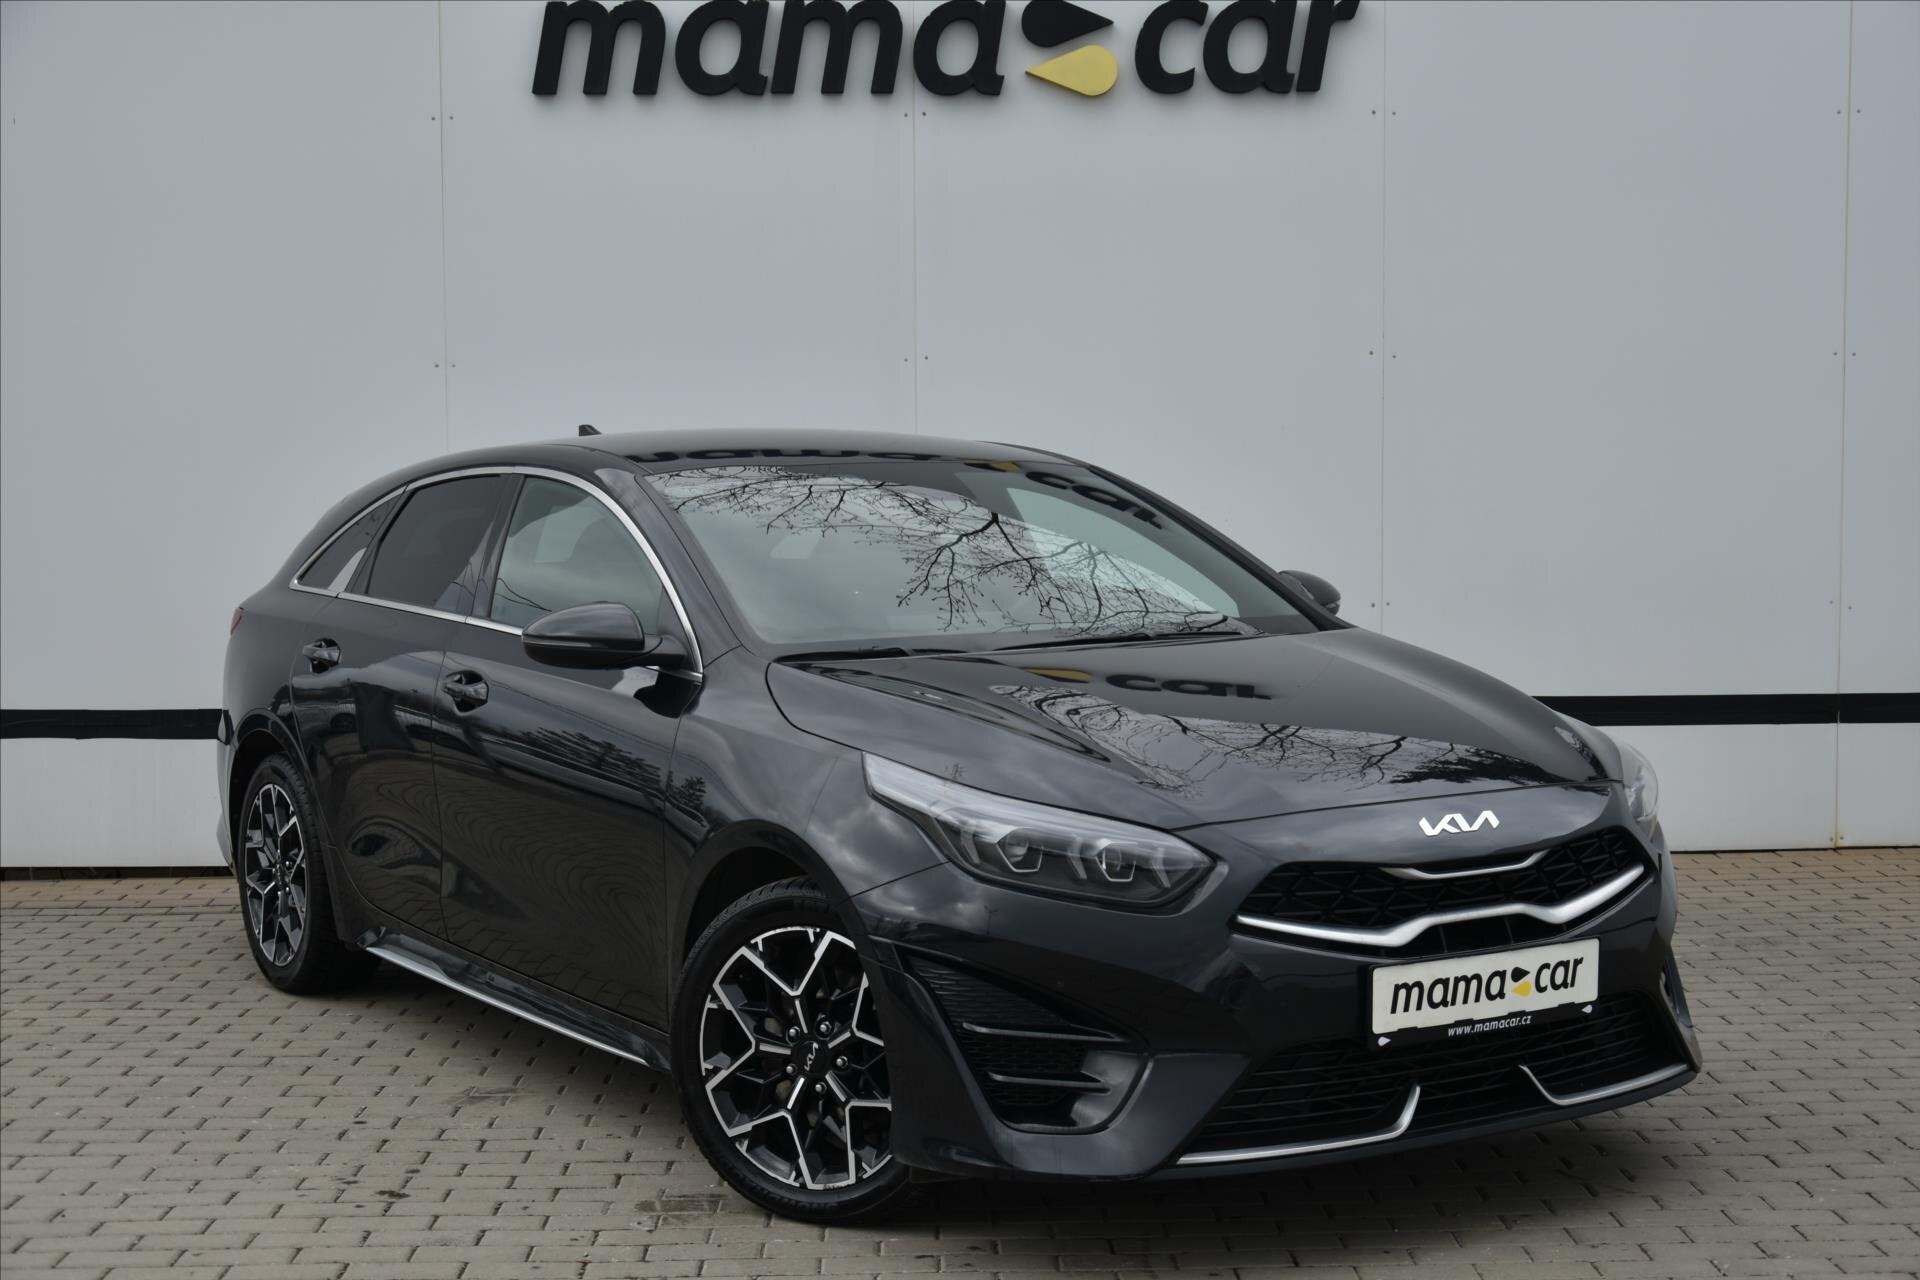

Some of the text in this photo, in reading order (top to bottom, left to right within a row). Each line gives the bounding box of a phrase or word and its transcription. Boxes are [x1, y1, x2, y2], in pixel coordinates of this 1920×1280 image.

[531, 0, 1360, 96] mama car
[1390, 957, 1584, 1014] mama car
[1448, 1013, 1532, 1037] www.mamacar.cz
